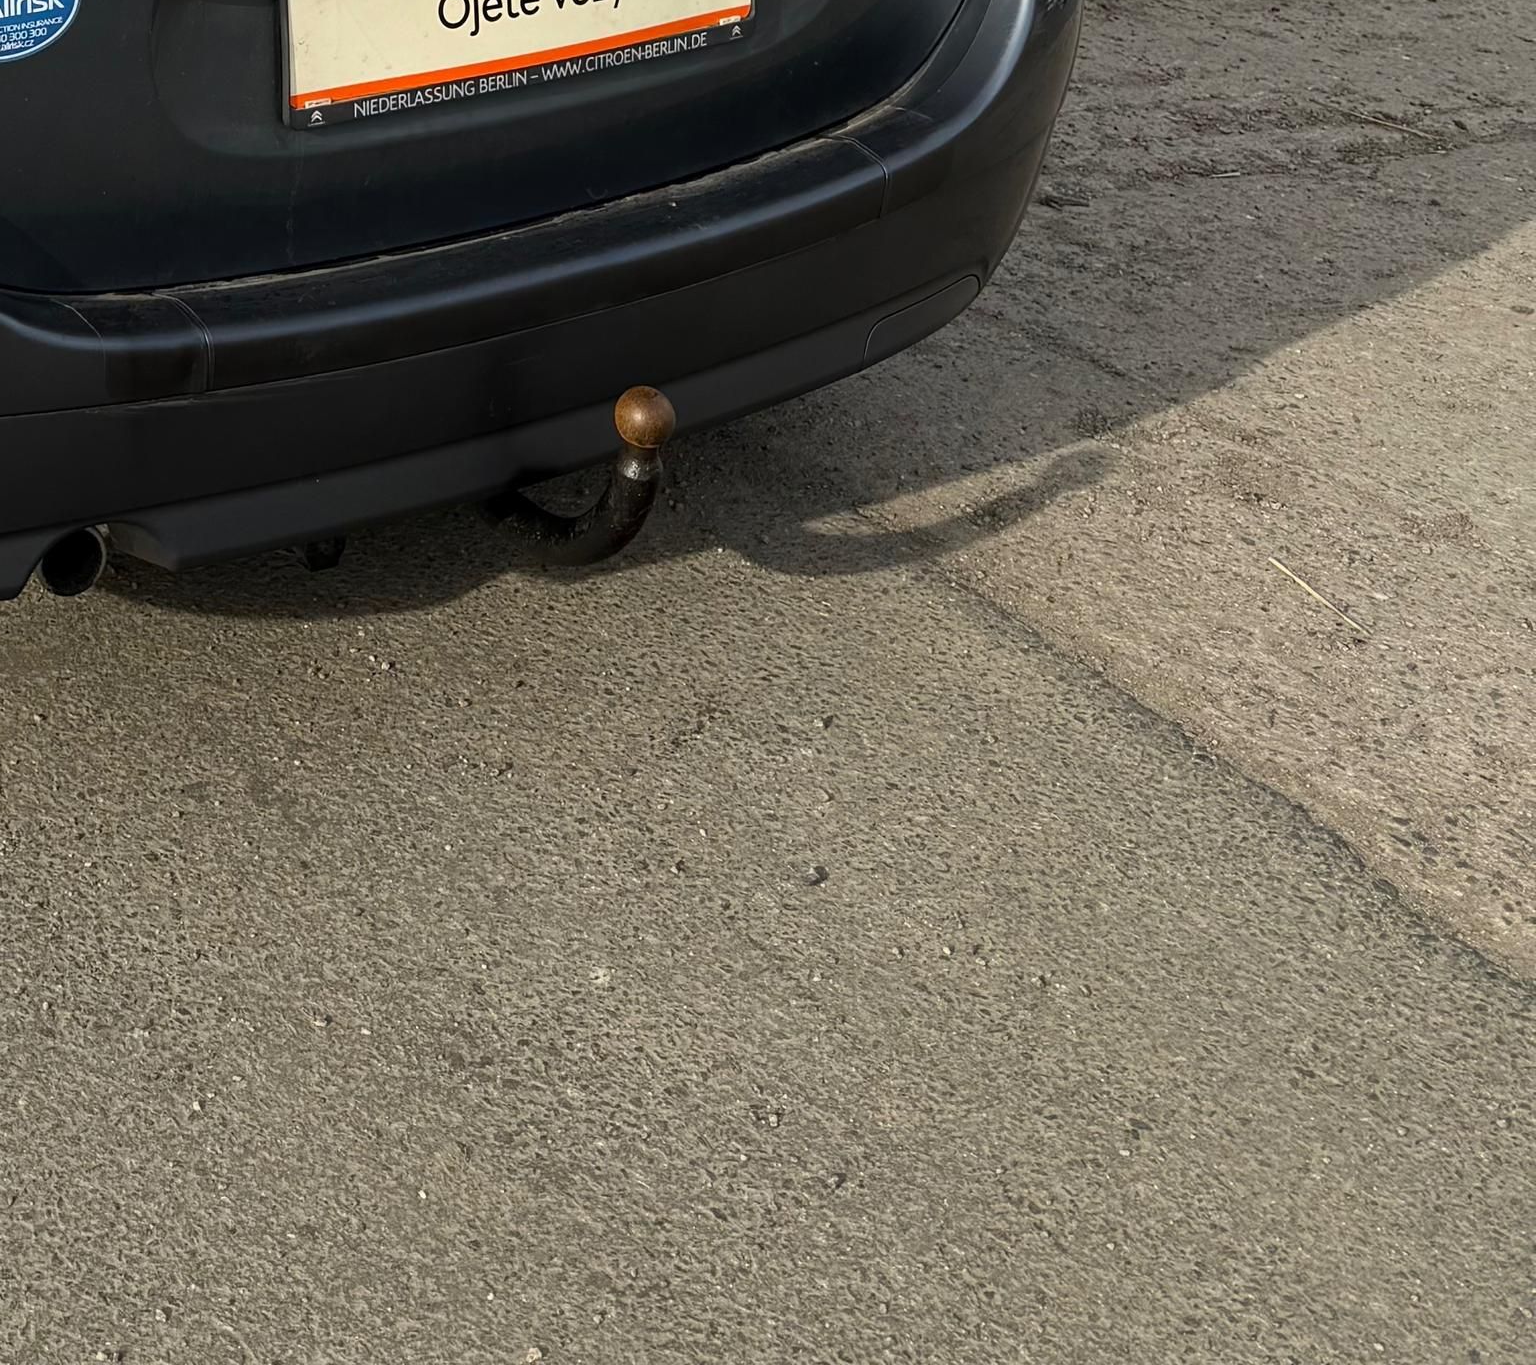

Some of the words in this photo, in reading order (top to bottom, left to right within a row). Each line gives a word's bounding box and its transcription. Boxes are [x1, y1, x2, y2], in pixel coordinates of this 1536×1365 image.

[21, 16, 63, 30] INSURANCE
[9, 30, 28, 42] 300
[28, 27, 48, 39] 300
[353, 80, 475, 118] NIEDERLASSUNG
[479, 70, 527, 94] BERLIN
[541, 31, 707, 82] WWW.CITROEN-BERLIN.DE
